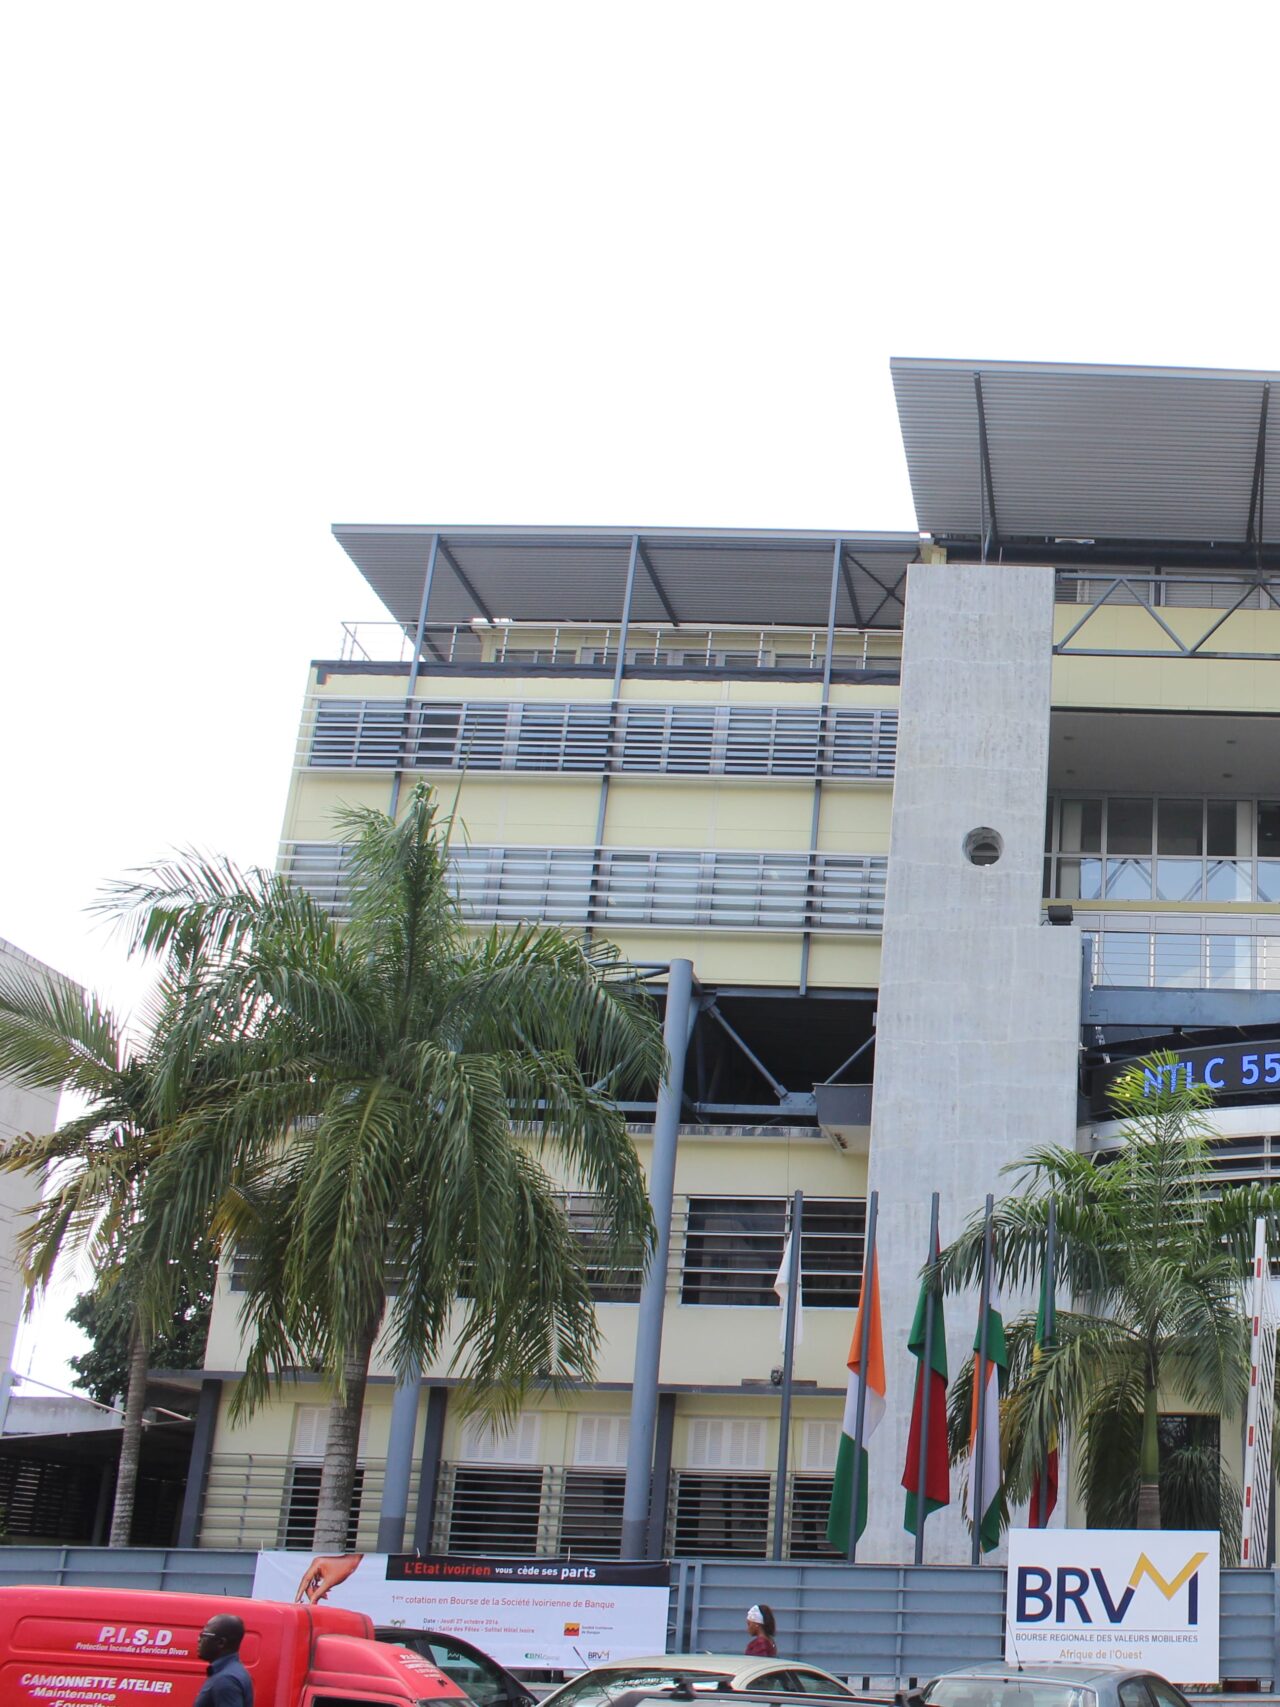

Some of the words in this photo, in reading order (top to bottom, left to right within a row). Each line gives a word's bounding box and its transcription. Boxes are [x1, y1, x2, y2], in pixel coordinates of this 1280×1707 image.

[404, 1562, 440, 1575] L'Etat
[443, 1563, 491, 1576] ivoirien
[495, 1567, 513, 1575] vous
[517, 1566, 540, 1576] cède
[561, 1567, 596, 1580] parts
[1016, 1552, 1209, 1625] BRVM
[405, 1596, 436, 1605] cotation
[450, 1596, 479, 1605] Bourse
[480, 1597, 490, 1606] de
[492, 1597, 500, 1606] la
[501, 1597, 530, 1607] Société
[532, 1598, 571, 1608] Ivoirienne
[573, 1599, 583, 1608] de
[585, 1600, 615, 1610] Banque
[99, 1626, 173, 1646] P.I.S.D
[1015, 1633, 1048, 1641] BOURSE
[1050, 1634, 1095, 1642] REGIONALE
[1097, 1635, 1112, 1643] DES
[1114, 1634, 1150, 1643] VALEURS
[1151, 1635, 1198, 1643] MOBILIERES
[75, 1642, 108, 1651] Protection
[109, 1644, 136, 1653] Incendie
[140, 1647, 168, 1655] Services
[168, 1648, 189, 1656] Divers
[1059, 1649, 1094, 1660] Afrique
[1096, 1650, 1107, 1659] de
[1109, 1649, 1143, 1660] l'Ouest
[21, 1674, 117, 1689] CAMIONNETTE
[118, 1678, 173, 1694] ATELIER
[29, 1686, 116, 1701] -Maintenance
